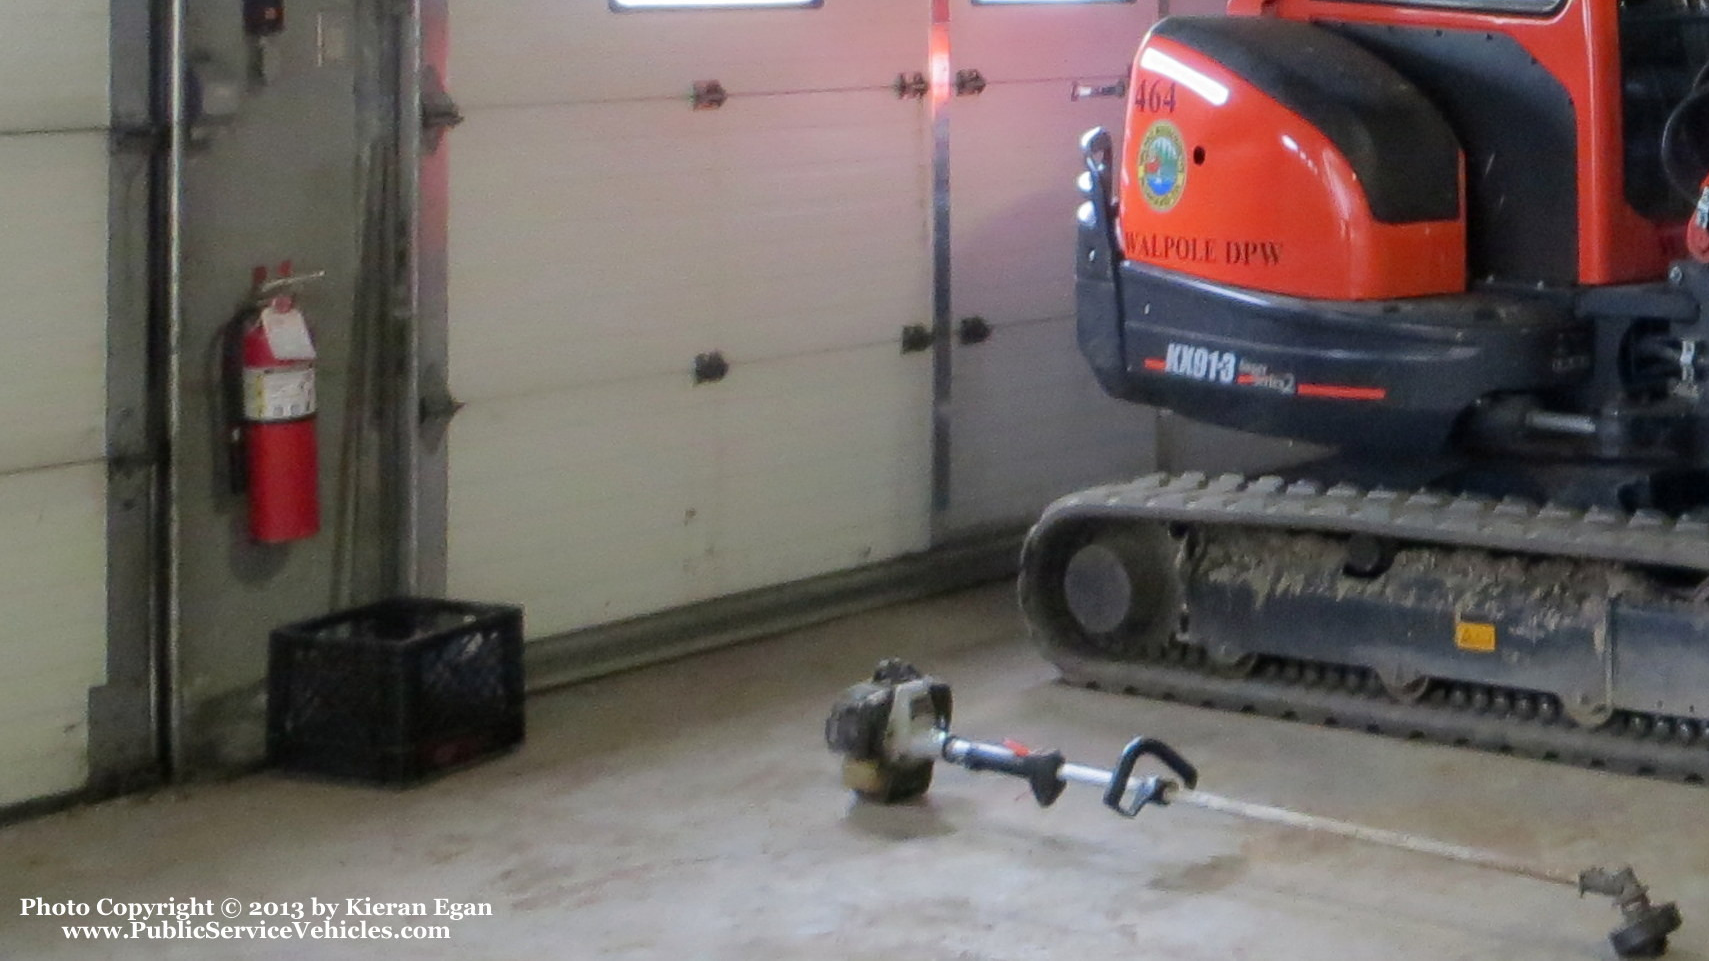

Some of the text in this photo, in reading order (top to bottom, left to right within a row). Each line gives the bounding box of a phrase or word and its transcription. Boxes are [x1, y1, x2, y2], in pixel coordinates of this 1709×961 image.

[1134, 79, 1177, 114] 464
[1124, 232, 1283, 266] WALPOLE DPW
